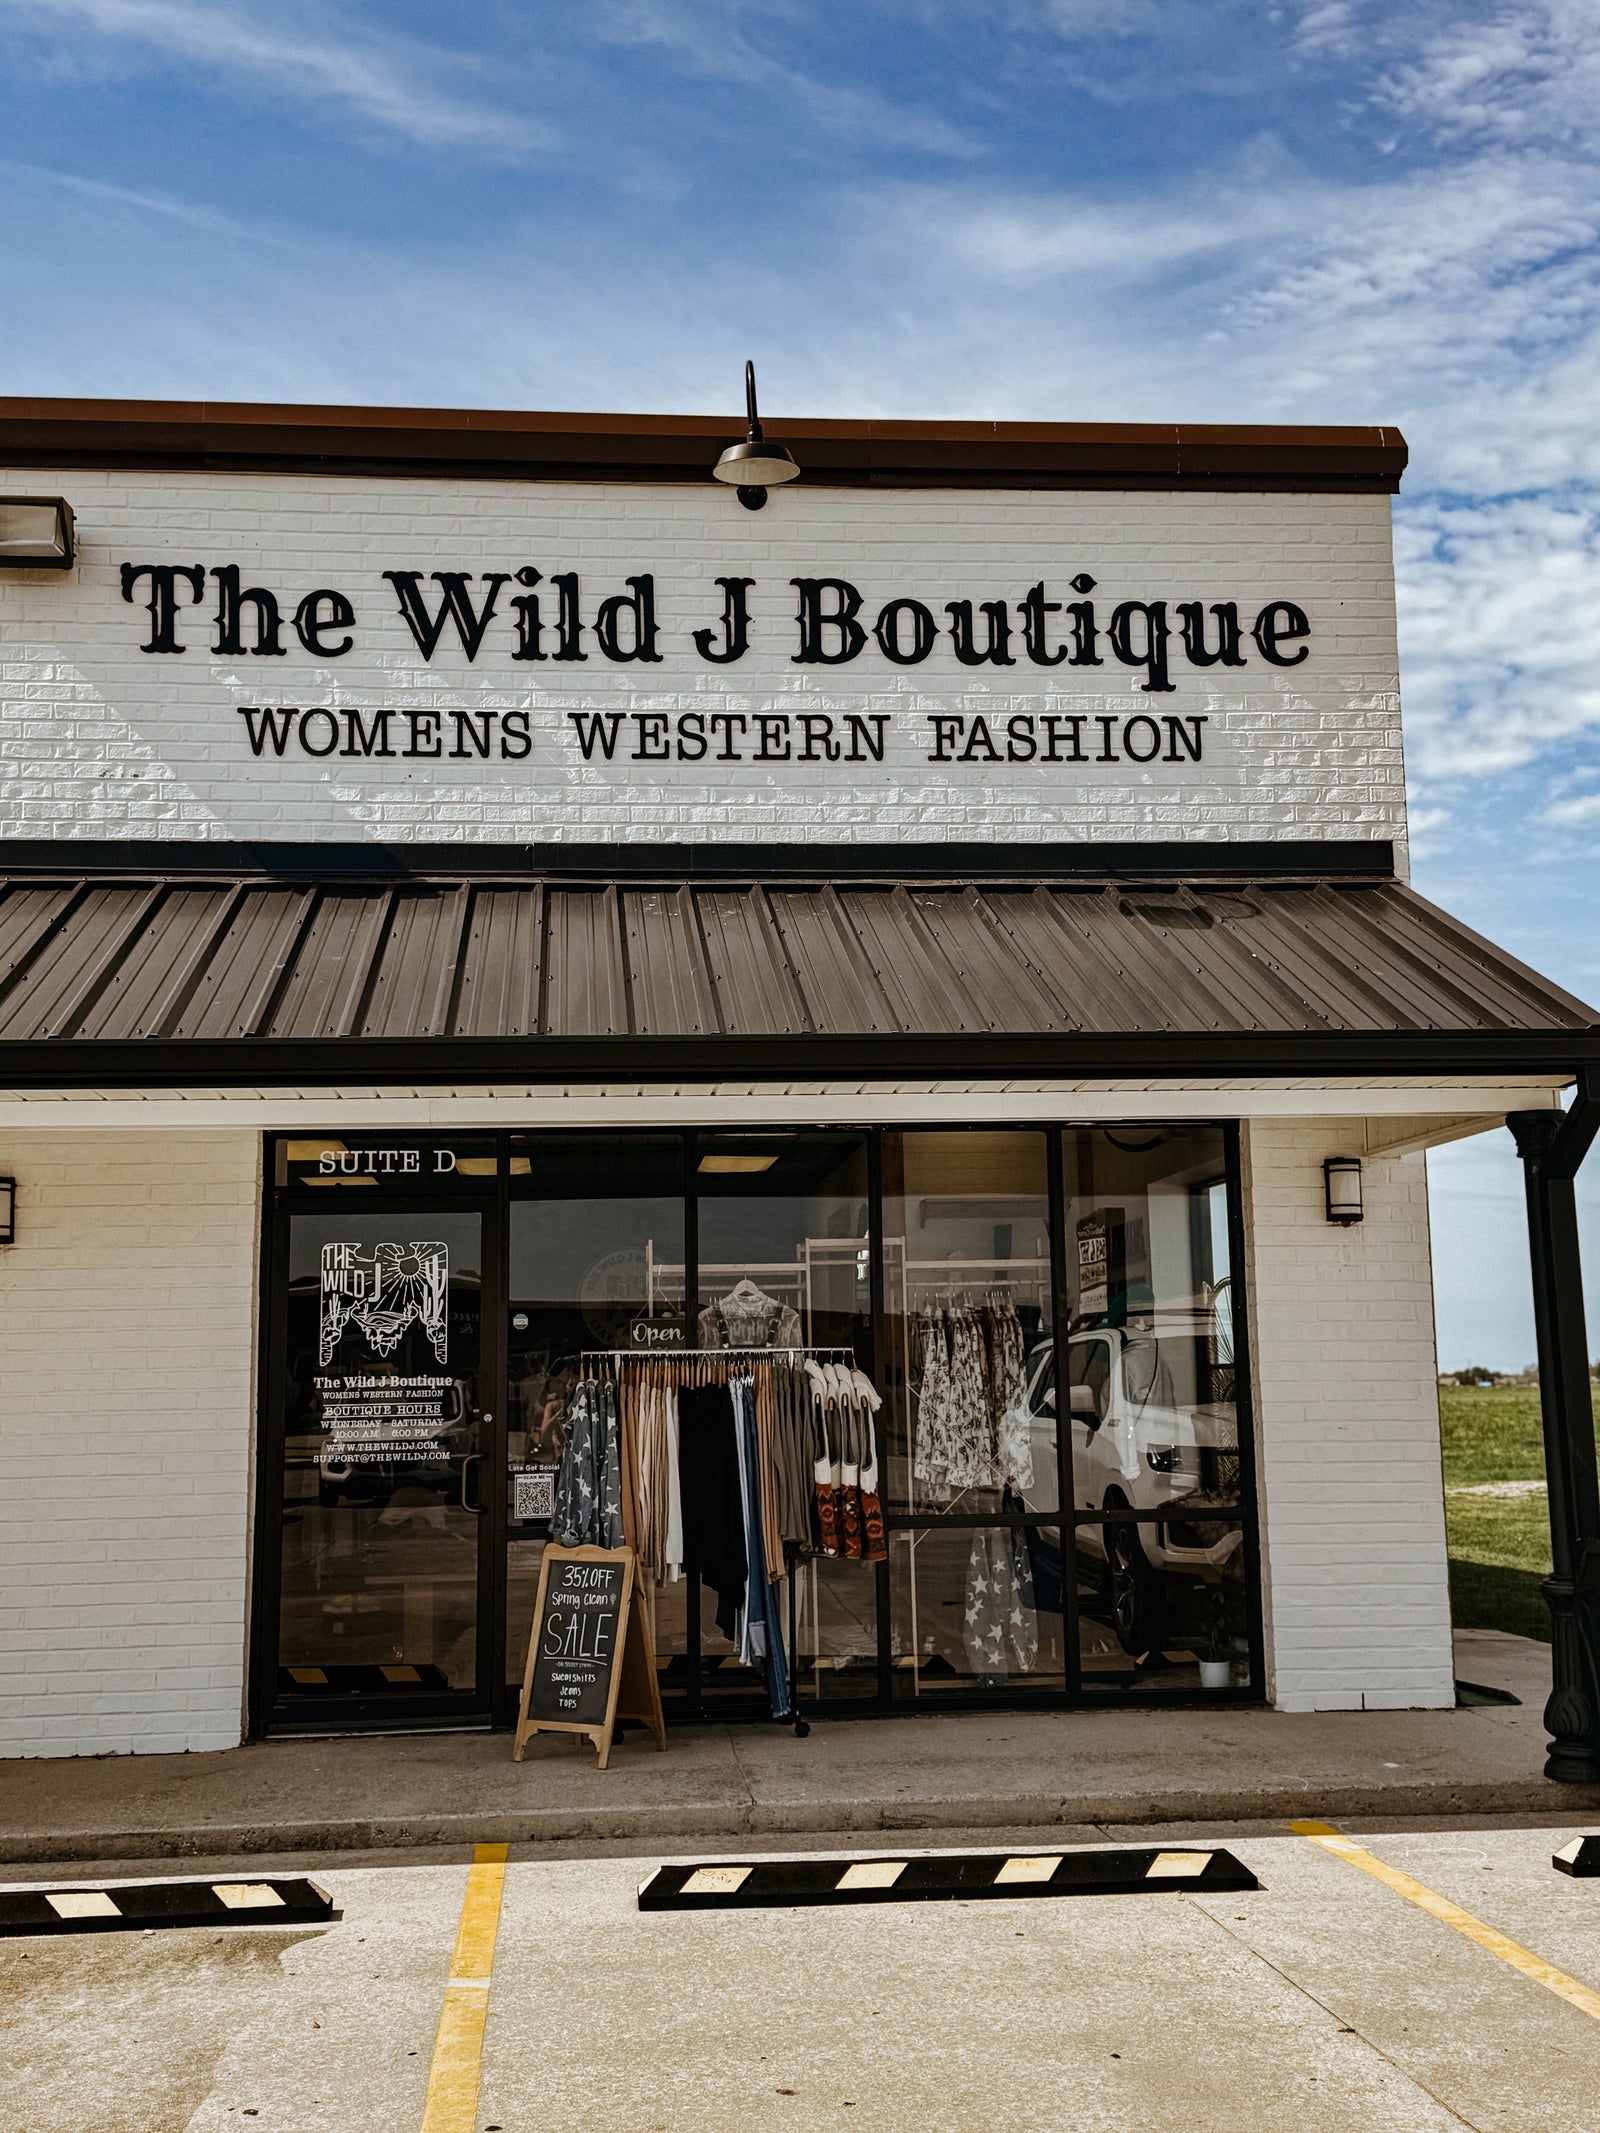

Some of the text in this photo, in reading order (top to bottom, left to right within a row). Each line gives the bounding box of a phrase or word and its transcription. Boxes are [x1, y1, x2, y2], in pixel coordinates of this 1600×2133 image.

[120, 562, 1312, 692] The Wild J Boutique
[237, 707, 1209, 763] WOMENS WESTERN FASHION
[319, 1149, 456, 1173] SUITE D
[324, 1242, 355, 1269] THE
[323, 1262, 381, 1302] WILD J
[632, 1323, 685, 1347] Open
[313, 1374, 453, 1389] The Wild J Boutique
[322, 1389, 444, 1399] WOMENS WESTERN FASHION
[325, 1405, 441, 1417] BOUTIQUE HOURS
[320, 1419, 382, 1429] WEDNESDAY
[391, 1418, 445, 1427] SATURDAY
[335, 1430, 360, 1439] 10:00
[362, 1430, 379, 1438] AM
[391, 1429, 411, 1437] 6:00
[414, 1428, 429, 1437] PM
[326, 1441, 439, 1452] WWW.THEWILDJ.COM
[313, 1452, 451, 1463] SUPPORT@THEWILDJ.COM
[539, 1463, 560, 1471] Social
[551, 1590, 580, 1610] Spring
[544, 1612, 613, 1657] SALE
